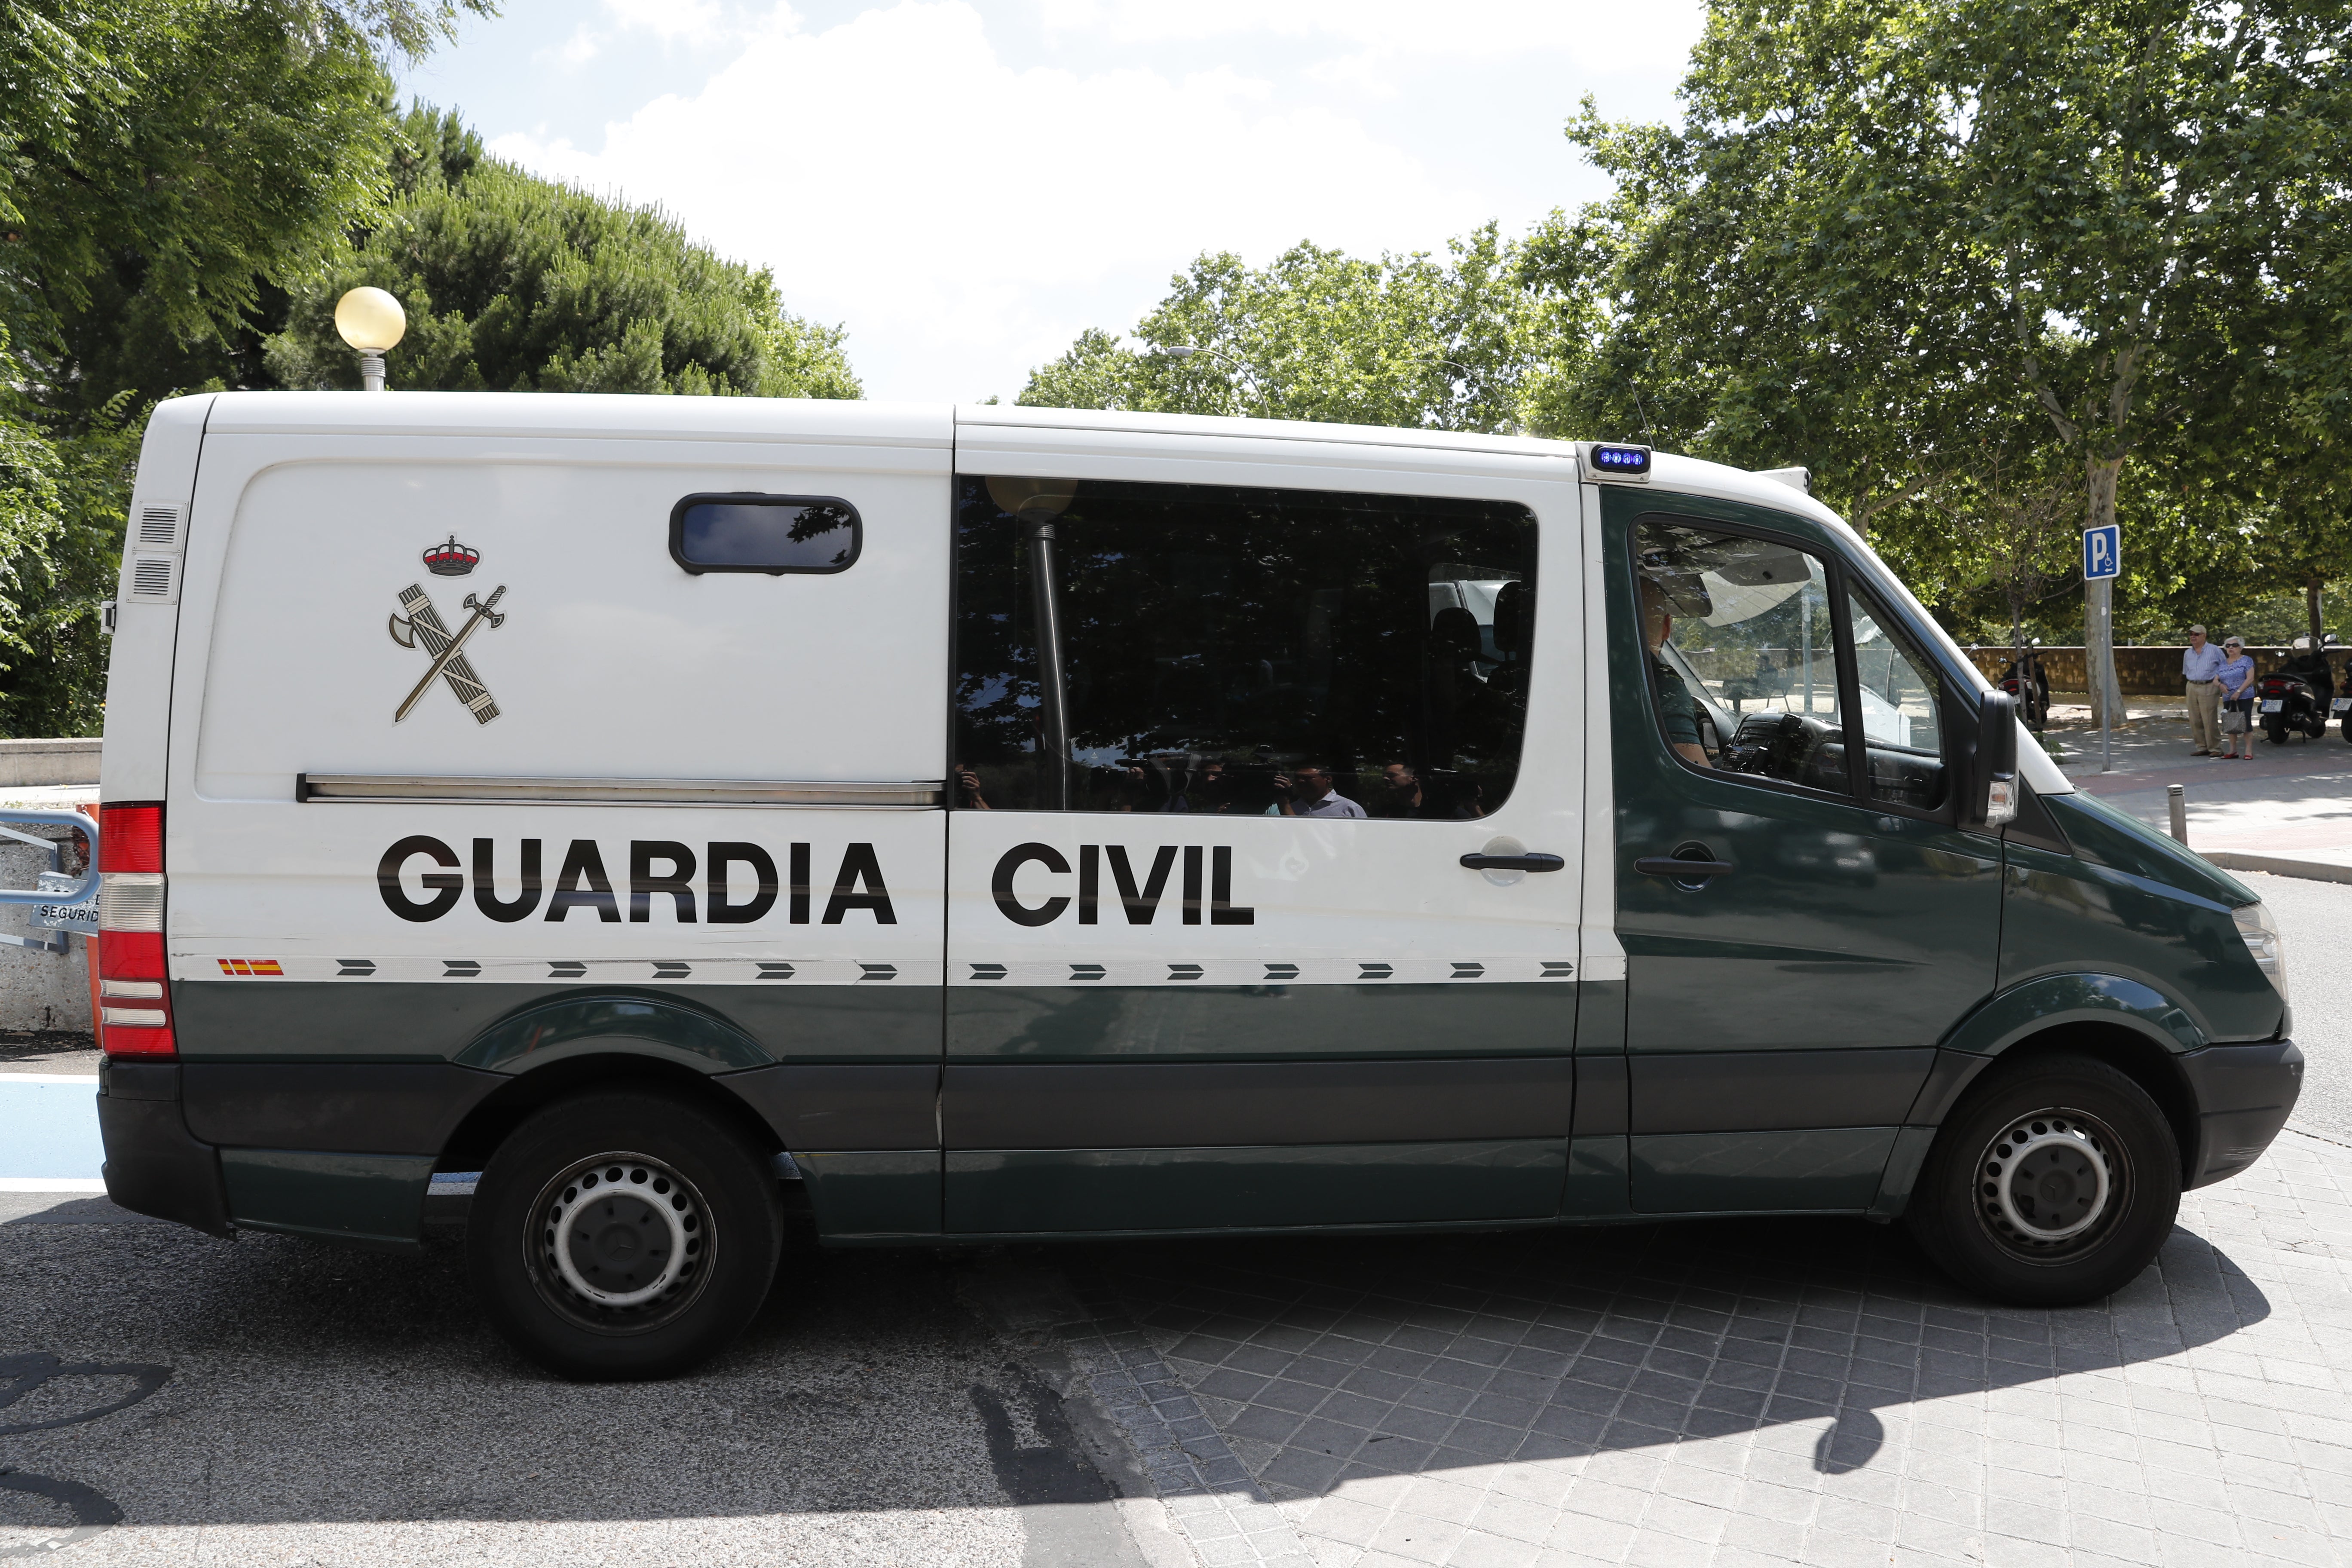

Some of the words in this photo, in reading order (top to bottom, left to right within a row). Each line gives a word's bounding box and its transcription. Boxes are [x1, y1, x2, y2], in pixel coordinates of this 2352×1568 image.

[2092, 532, 2107, 572] P
[377, 835, 897, 924] GUARDIA
[992, 842, 1254, 927] CIVIL
[40, 905, 98, 922] SEGURID
